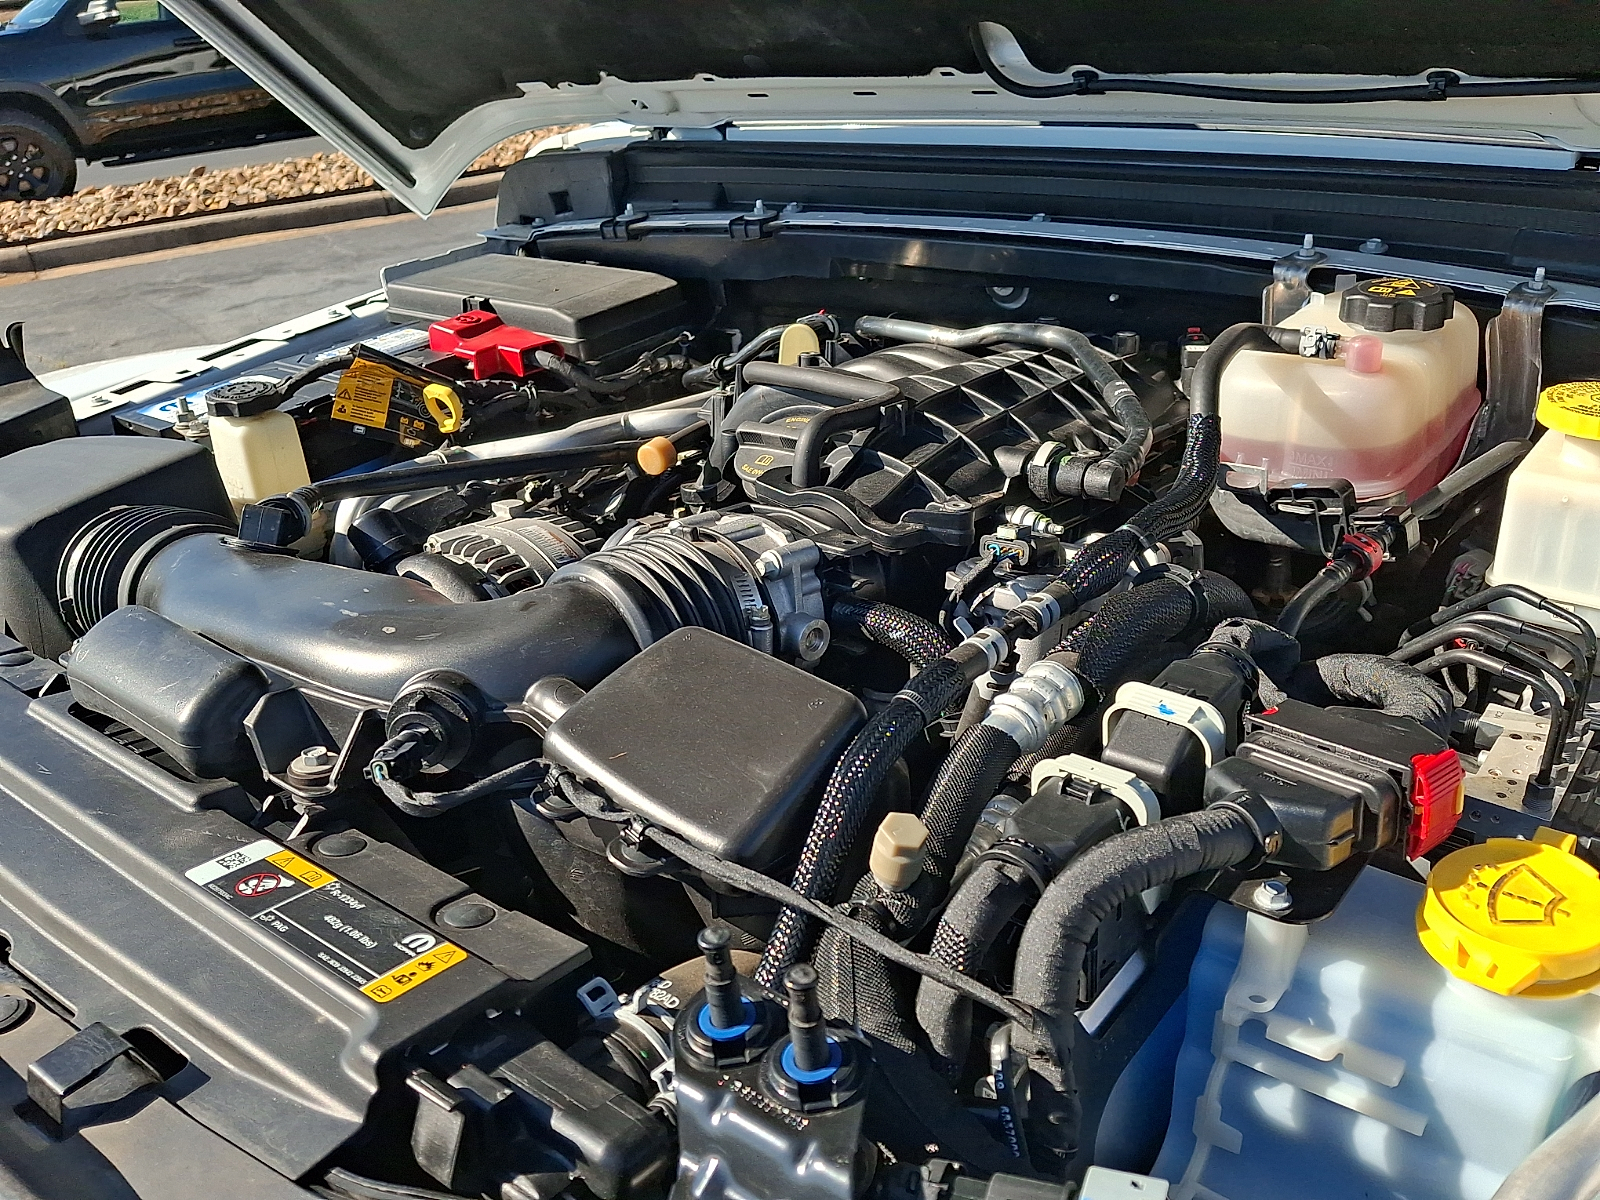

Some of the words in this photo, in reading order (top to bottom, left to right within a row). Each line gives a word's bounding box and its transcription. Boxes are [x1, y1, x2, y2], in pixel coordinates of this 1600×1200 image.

[330, 889, 366, 910] R-1234yf
[270, 920, 289, 933] PAG
[323, 914, 344, 930] 482g
[358, 934, 378, 949] lbs)
